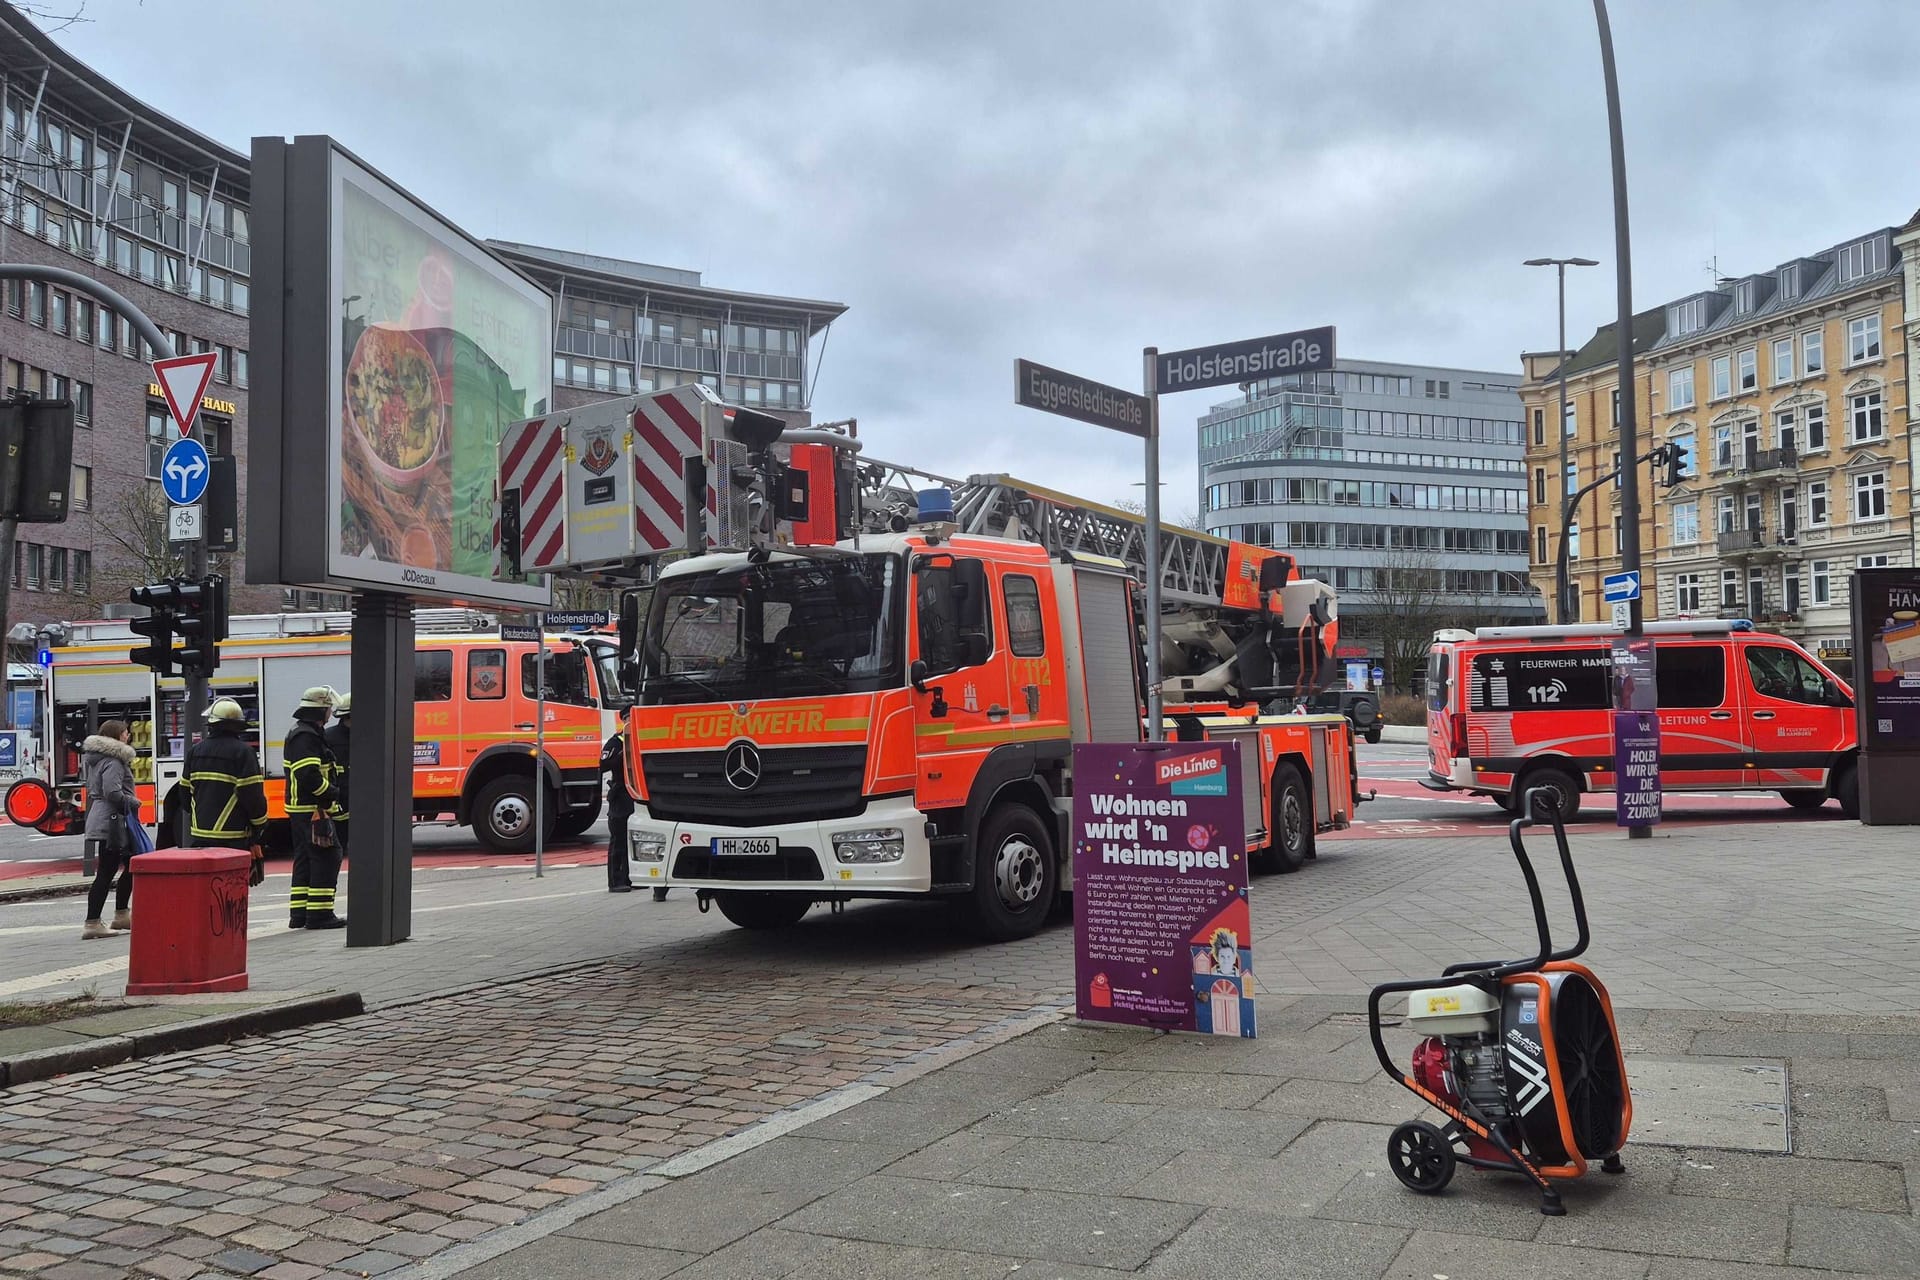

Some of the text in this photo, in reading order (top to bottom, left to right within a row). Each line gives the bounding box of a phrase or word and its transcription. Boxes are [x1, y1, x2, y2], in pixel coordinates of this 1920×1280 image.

[1166, 337, 1322, 385] Holstenstraße
[1029, 368, 1143, 425] Eggerstedtstraße
[401, 568, 436, 586] JCDecaux
[547, 612, 606, 624] Holstenstraße
[1024, 657, 1051, 686] 112
[1520, 659, 1578, 669] FEUERWEHR
[1527, 685, 1560, 703] 112
[424, 711, 449, 726] 112
[670, 707, 824, 740] FEUERWEHR
[1659, 716, 1707, 725] LEITUNG
[1630, 750, 1657, 763] HOLEN
[1161, 756, 1218, 779] Die Linke
[1626, 763, 1659, 777] WIR UNS
[1194, 782, 1223, 792] Hamburg
[1640, 778, 1654, 791] DIE
[1090, 793, 1188, 817] Wohnen
[1623, 790, 1661, 806] ZUKUNFT
[1627, 803, 1660, 819] ZURÜCK
[1085, 816, 1139, 841] wird
[722, 838, 771, 855] HH 2666
[1102, 842, 1230, 874] Heimspiel
[1093, 890, 1107, 898] Euro
[1207, 897, 1218, 905] die
[1127, 884, 1154, 892] Wohnen
[1166, 885, 1205, 895] Grundrecht
[1088, 942, 1118, 954] Hamburg
[1089, 951, 1107, 960] Berlin
[1107, 953, 1123, 961] noch
[1506, 1032, 1540, 1057] EDITION
[1510, 1028, 1544, 1053] BLACK
